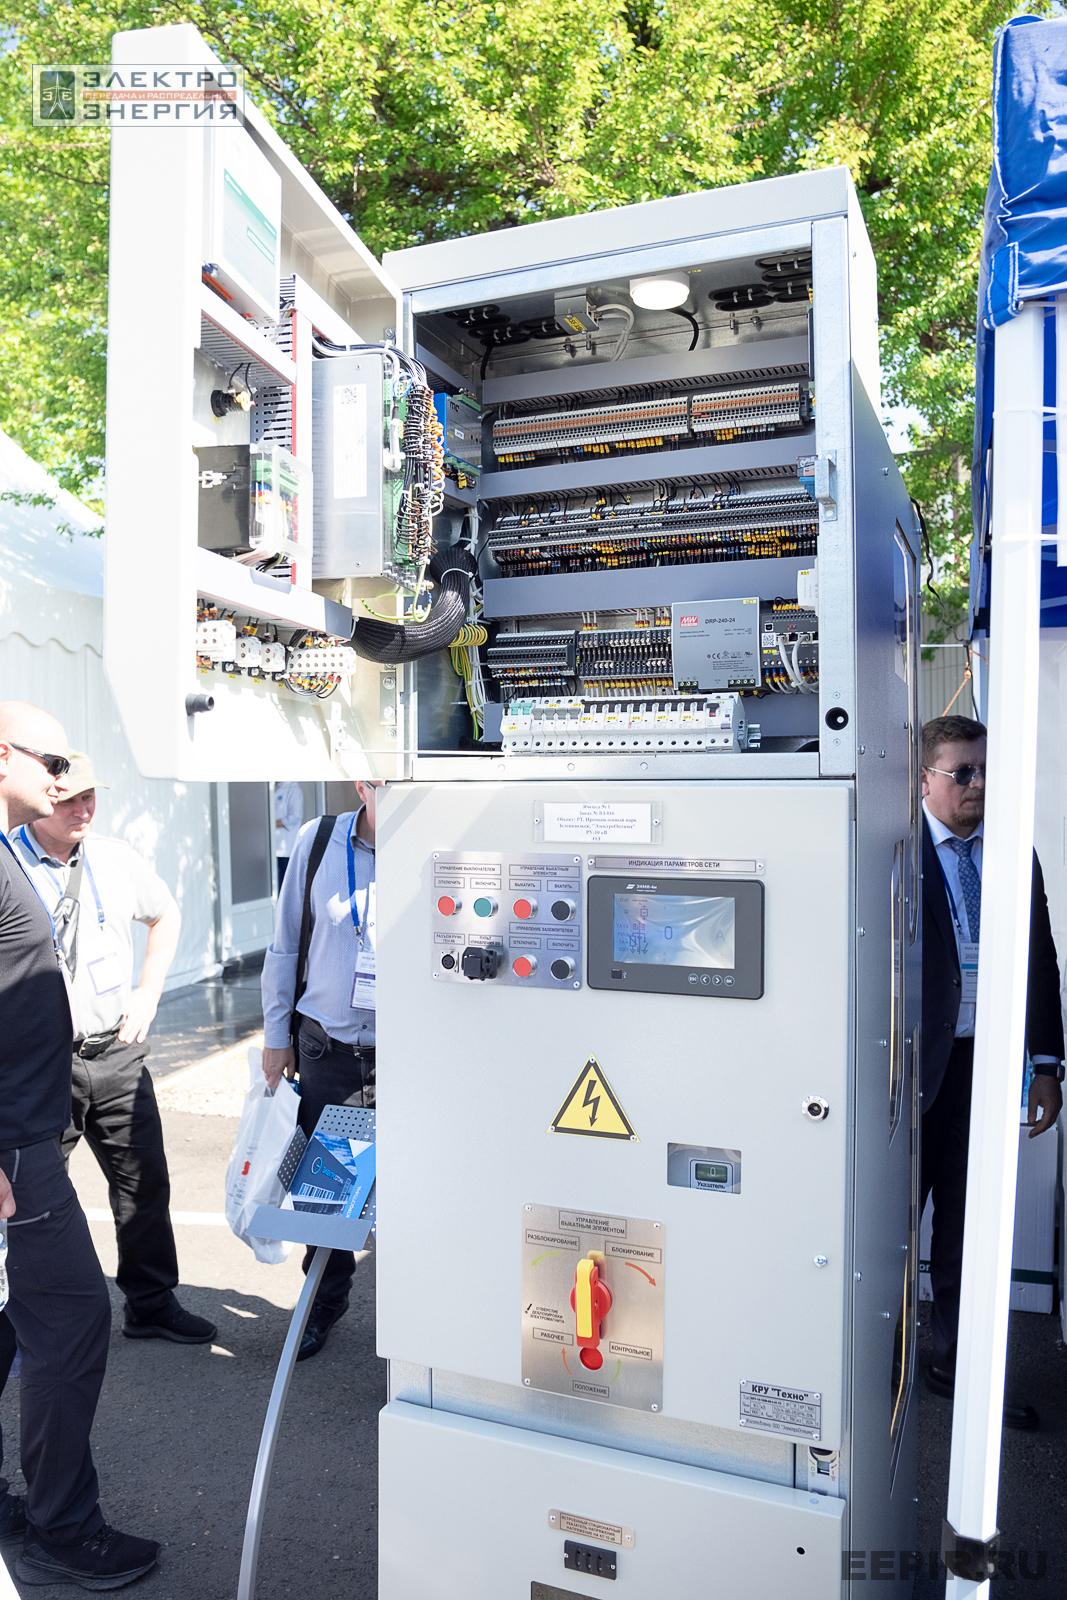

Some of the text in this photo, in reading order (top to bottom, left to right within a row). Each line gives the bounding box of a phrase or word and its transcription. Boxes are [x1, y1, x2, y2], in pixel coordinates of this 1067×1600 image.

[697, 1181, 726, 1190] Указатель
[561, 1220, 625, 1234] ВЫКАТНЫМ ЭЛЕМЕНТОМ
[576, 1216, 610, 1226] УПРАВЛЕНИЕ
[528, 1233, 578, 1247] РАЗБЛОКИРОВАНИЕ
[612, 1246, 655, 1258] БЛОКИРОВАНИЕ
[540, 1331, 565, 1341] РАБОЧЕЕ
[611, 1345, 650, 1357] КОНТРОЛЬНОЕ
[574, 1383, 608, 1394] ПОЛОЖЕНИЕ
[752, 1384, 809, 1401] КРУ "Техно"
